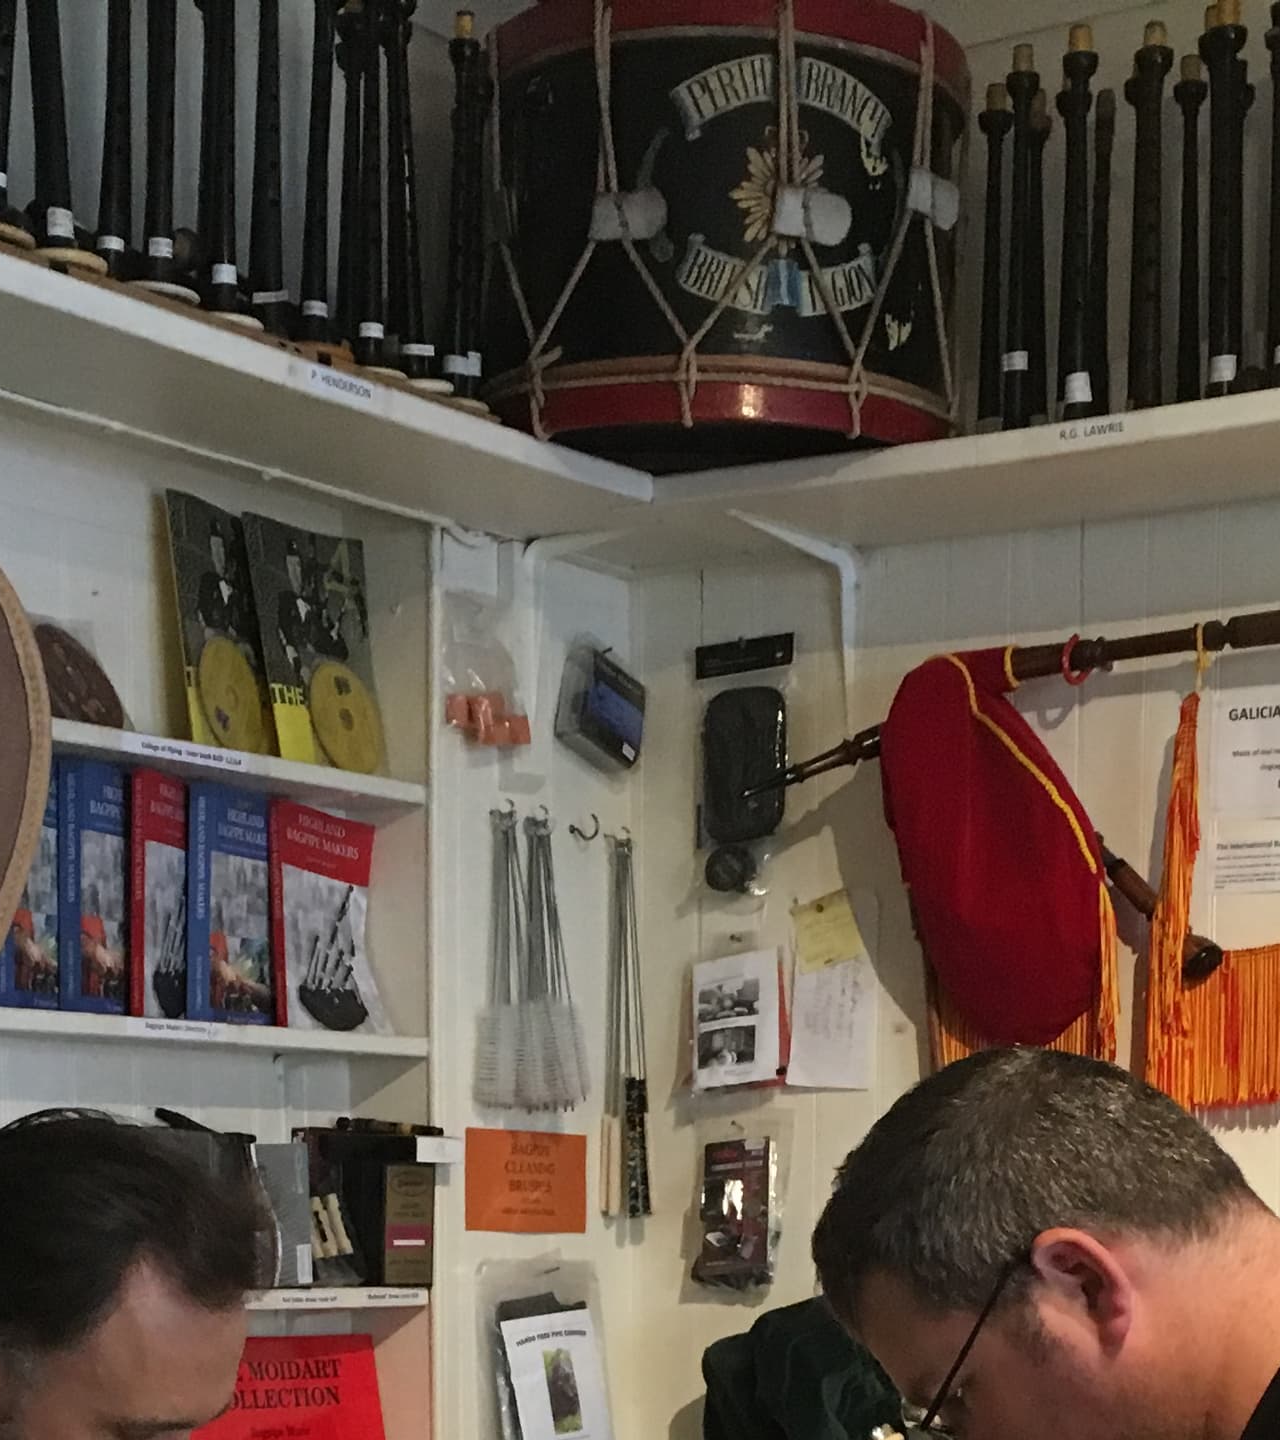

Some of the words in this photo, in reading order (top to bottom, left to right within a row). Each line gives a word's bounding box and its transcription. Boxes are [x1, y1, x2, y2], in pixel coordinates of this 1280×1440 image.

[685, 57, 769, 120] PERTH
[805, 60, 888, 138] BRANCH
[322, 374, 373, 400] HENDERSON
[1083, 421, 1125, 438] LAWRIE
[270, 682, 304, 705] THE
[297, 812, 346, 838] HIGHLAND
[286, 826, 321, 850] BAGPIPE
[321, 837, 360, 861] MAKERS
[248, 1359, 342, 1381] MOIDART
